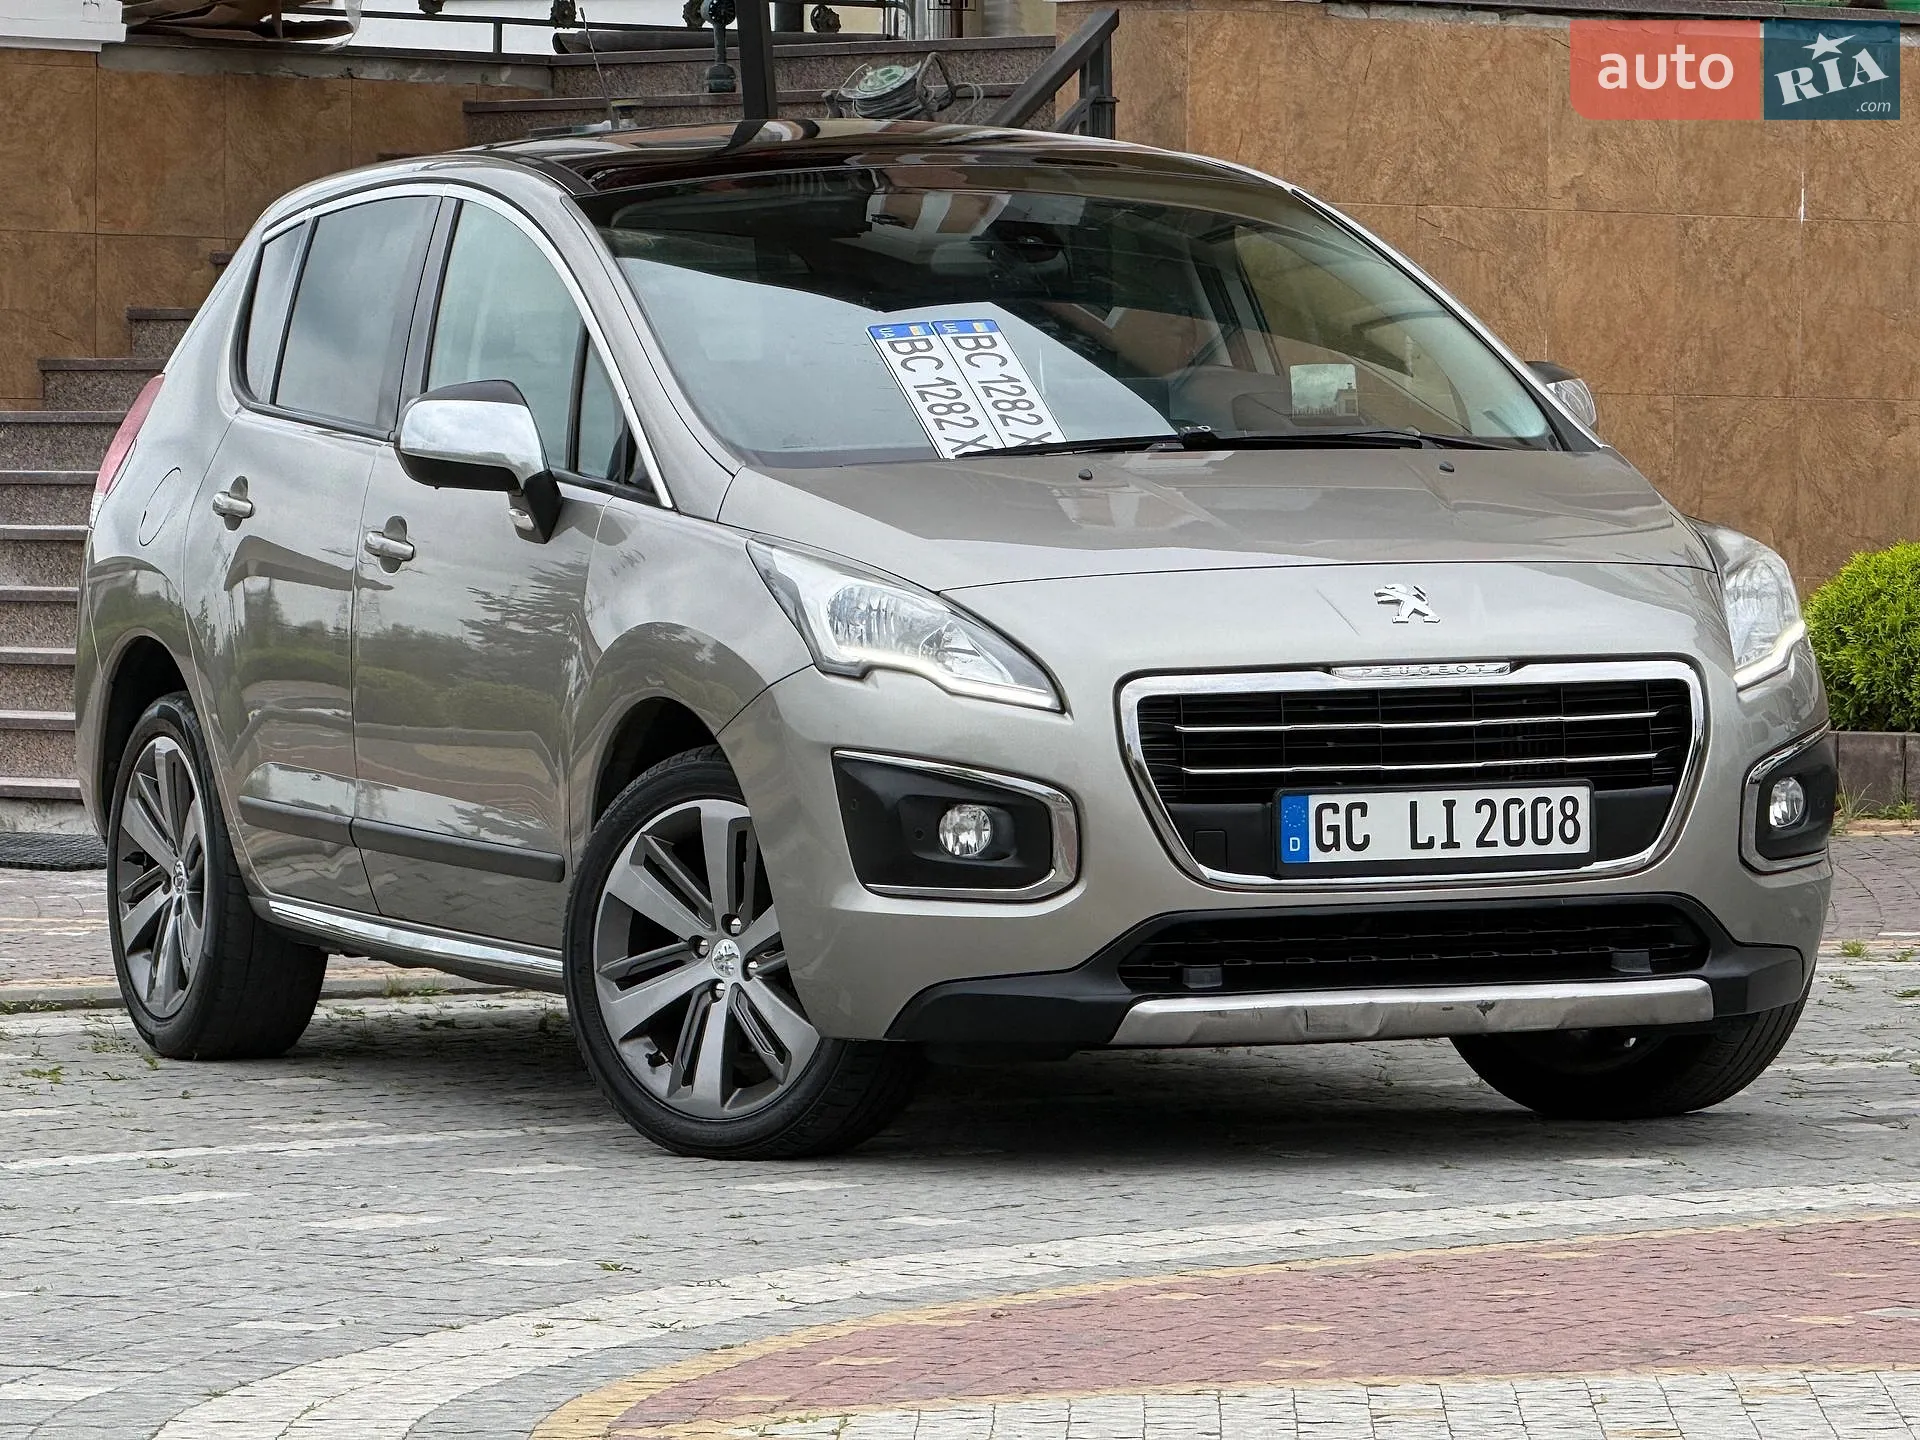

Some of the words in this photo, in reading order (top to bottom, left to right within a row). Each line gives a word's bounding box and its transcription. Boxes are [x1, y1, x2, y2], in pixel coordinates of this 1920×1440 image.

[878, 327, 895, 338] UA
[942, 323, 959, 333] UA
[887, 337, 944, 373] BC
[950, 334, 1008, 368] BC
[913, 376, 980, 431] 1282
[978, 373, 1044, 427] 1282
[1363, 664, 1487, 678] PEUGEOT
[1314, 801, 1371, 852] GC
[1409, 799, 1461, 850] LI
[1474, 795, 1581, 848] 2008
[1289, 837, 1301, 852] D
